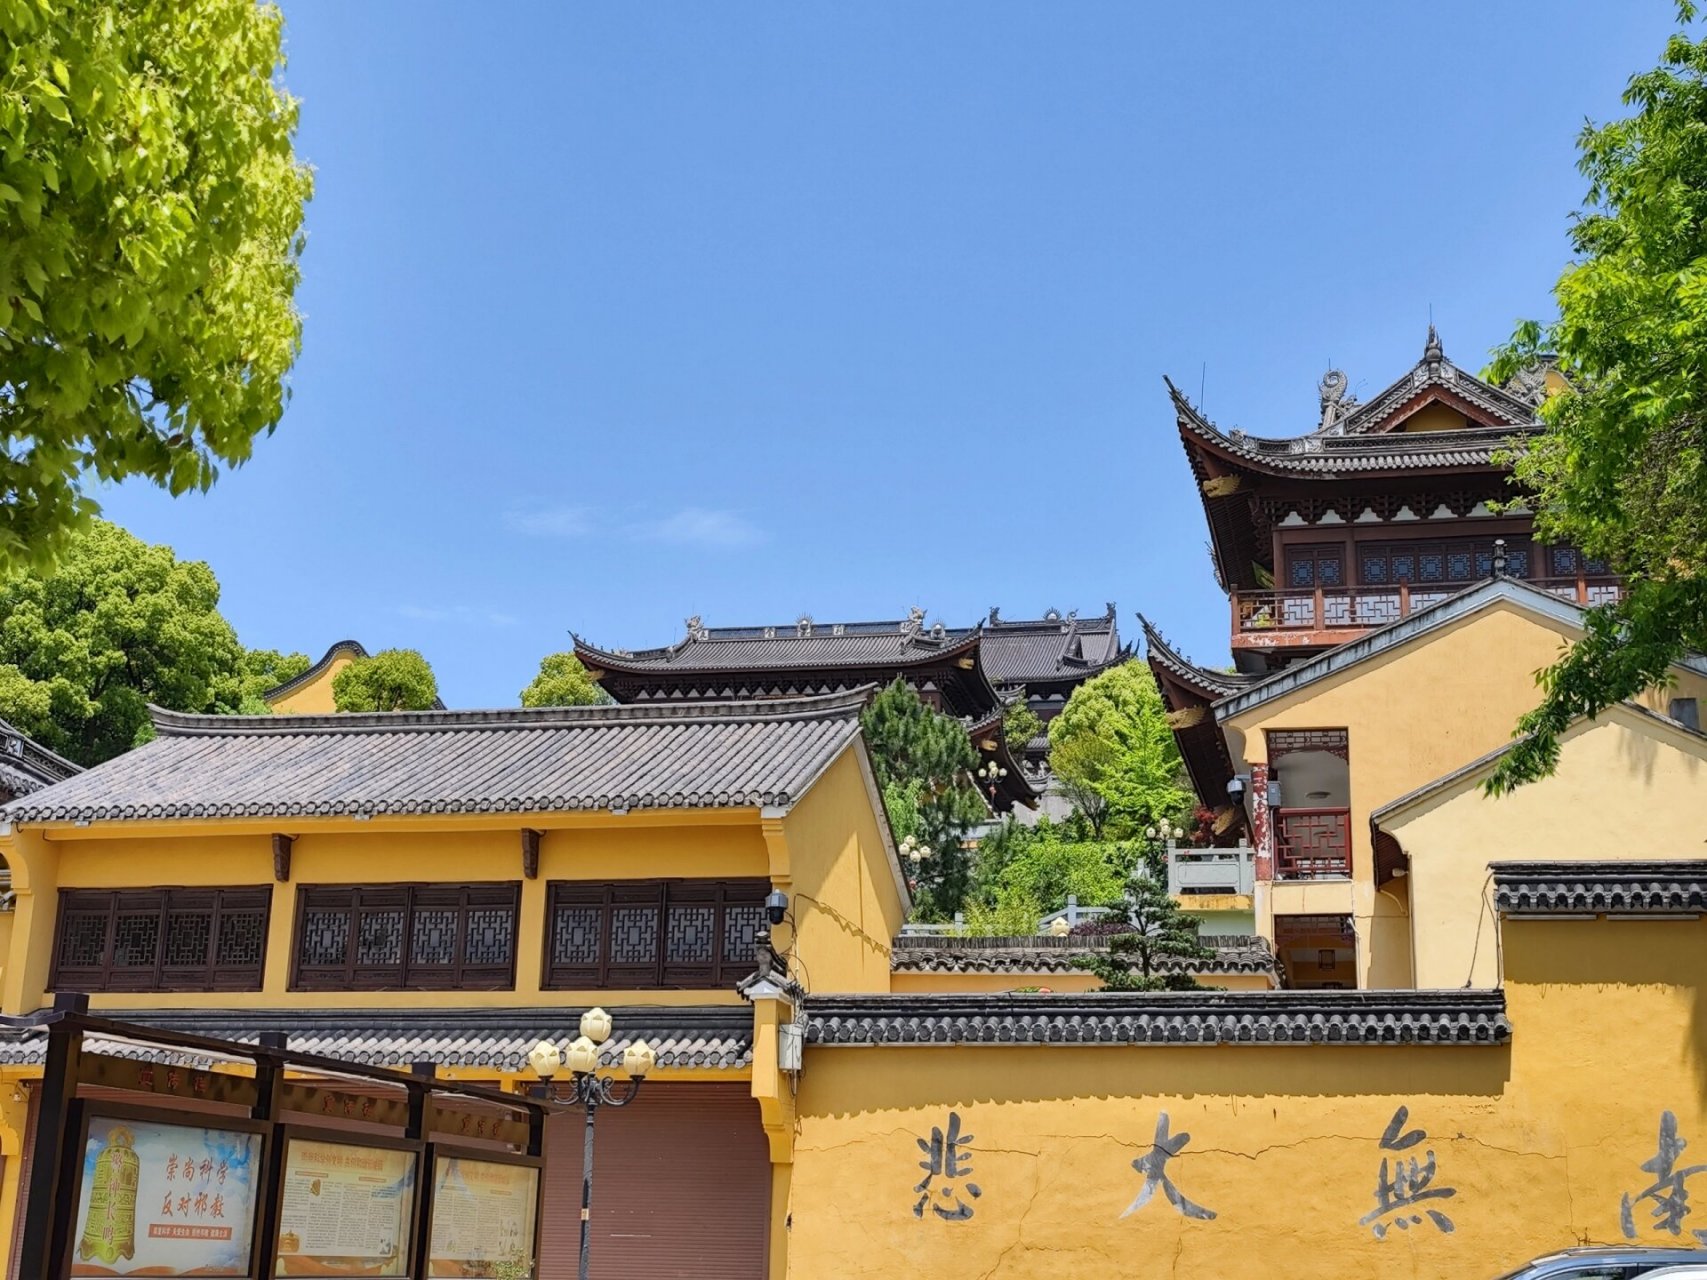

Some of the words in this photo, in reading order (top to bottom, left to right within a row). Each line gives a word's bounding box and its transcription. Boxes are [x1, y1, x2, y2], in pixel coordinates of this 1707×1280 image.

[166, 1153, 229, 1185] 崇尚科学
[161, 1190, 225, 1218] 反对邪教
